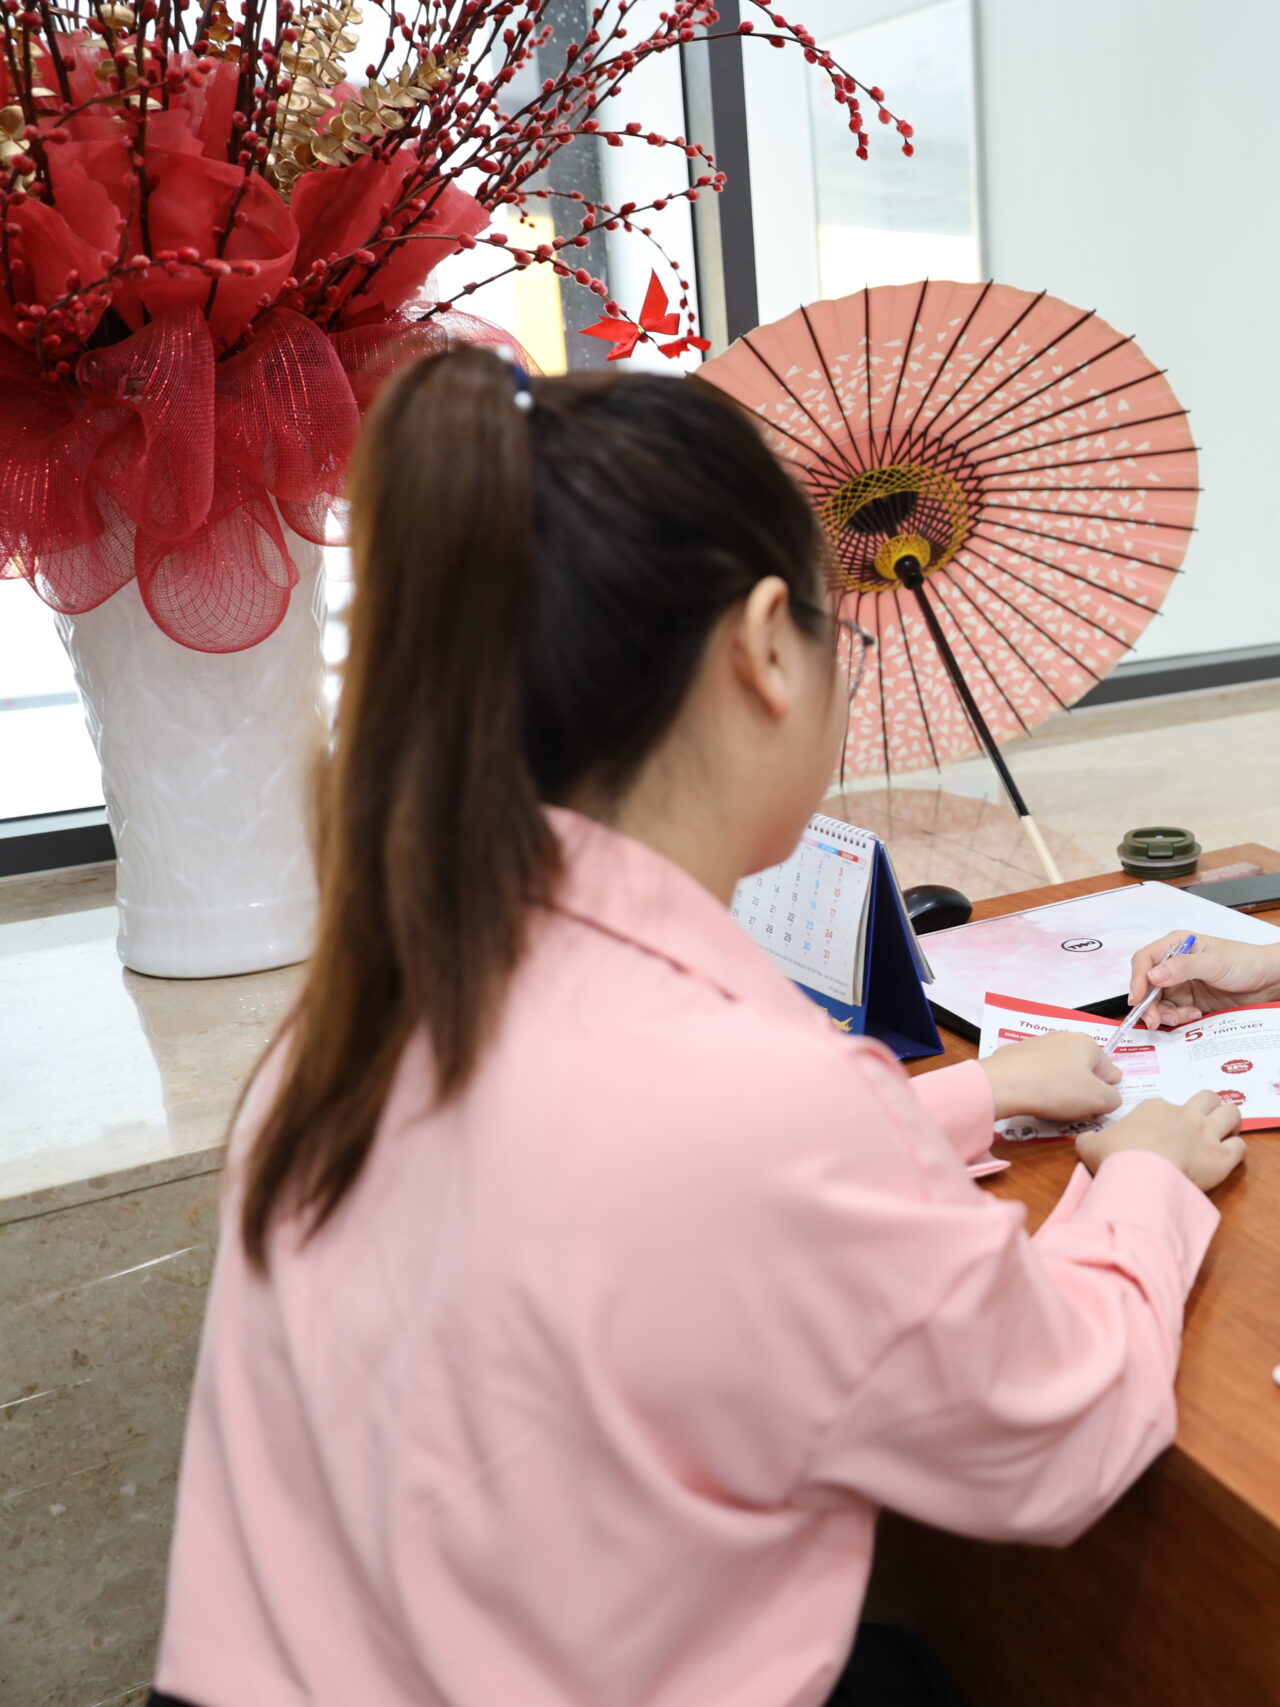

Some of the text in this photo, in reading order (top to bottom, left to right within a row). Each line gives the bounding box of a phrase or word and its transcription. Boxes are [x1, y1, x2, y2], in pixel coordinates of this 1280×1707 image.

[825, 927, 834, 939] 24
[765, 923, 774, 934] 28
[783, 931, 793, 943] 29
[823, 948, 831, 960] 31
[1184, 1027, 1204, 1042] 5
